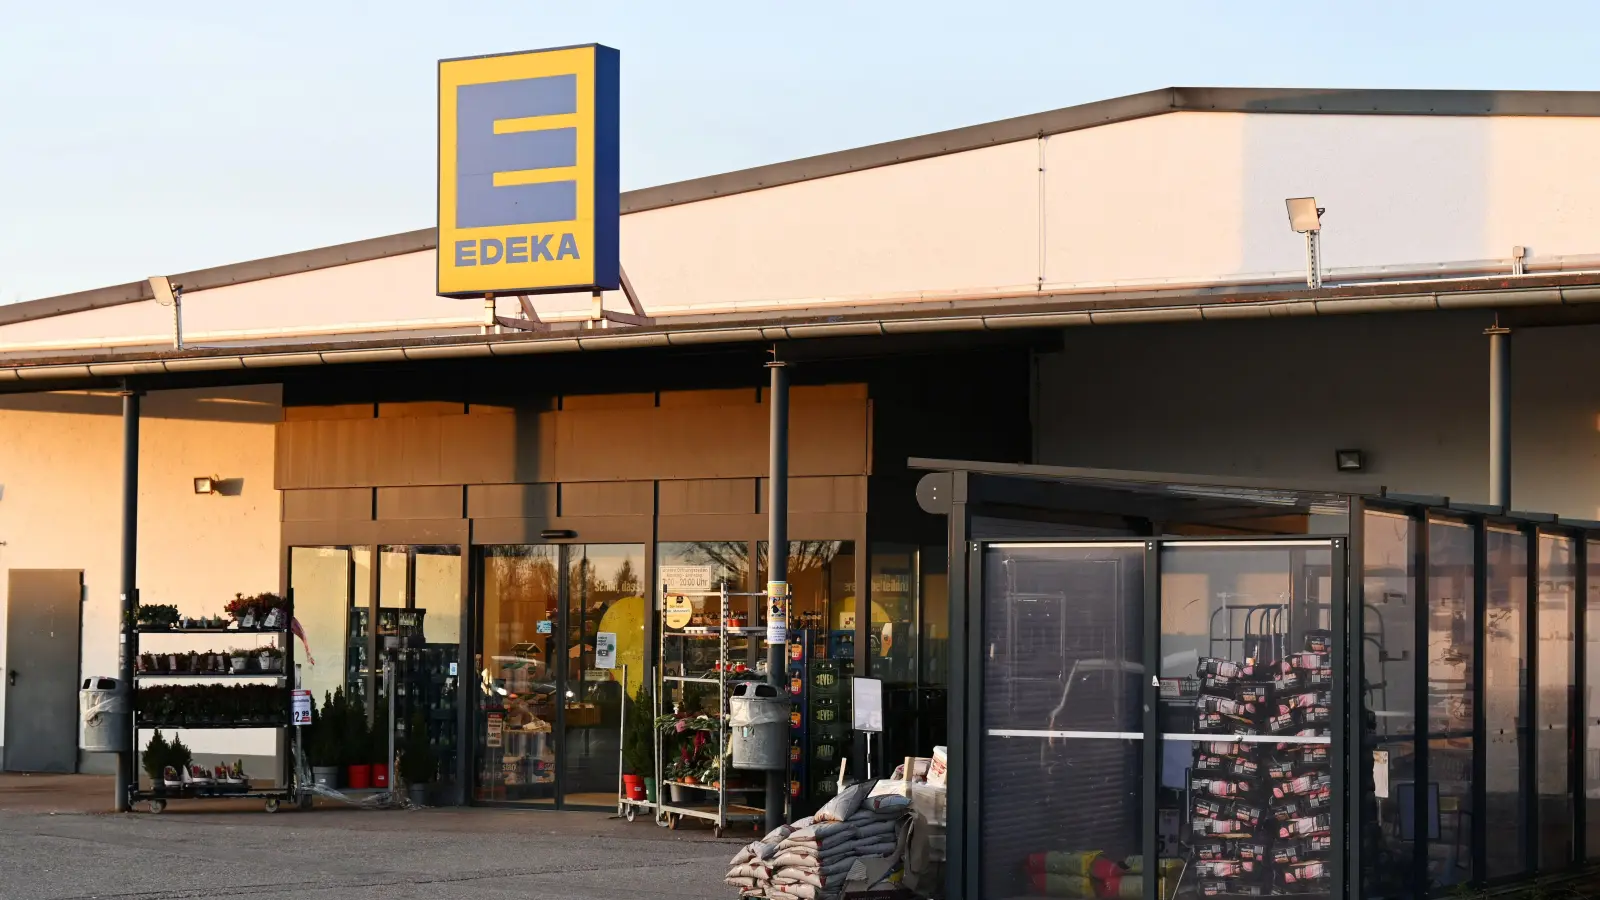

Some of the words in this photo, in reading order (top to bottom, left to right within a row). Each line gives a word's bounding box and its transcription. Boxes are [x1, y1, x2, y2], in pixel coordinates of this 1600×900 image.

[456, 74, 577, 229] E
[454, 233, 580, 267] EDEKA
[696, 578, 708, 586] Uhr
